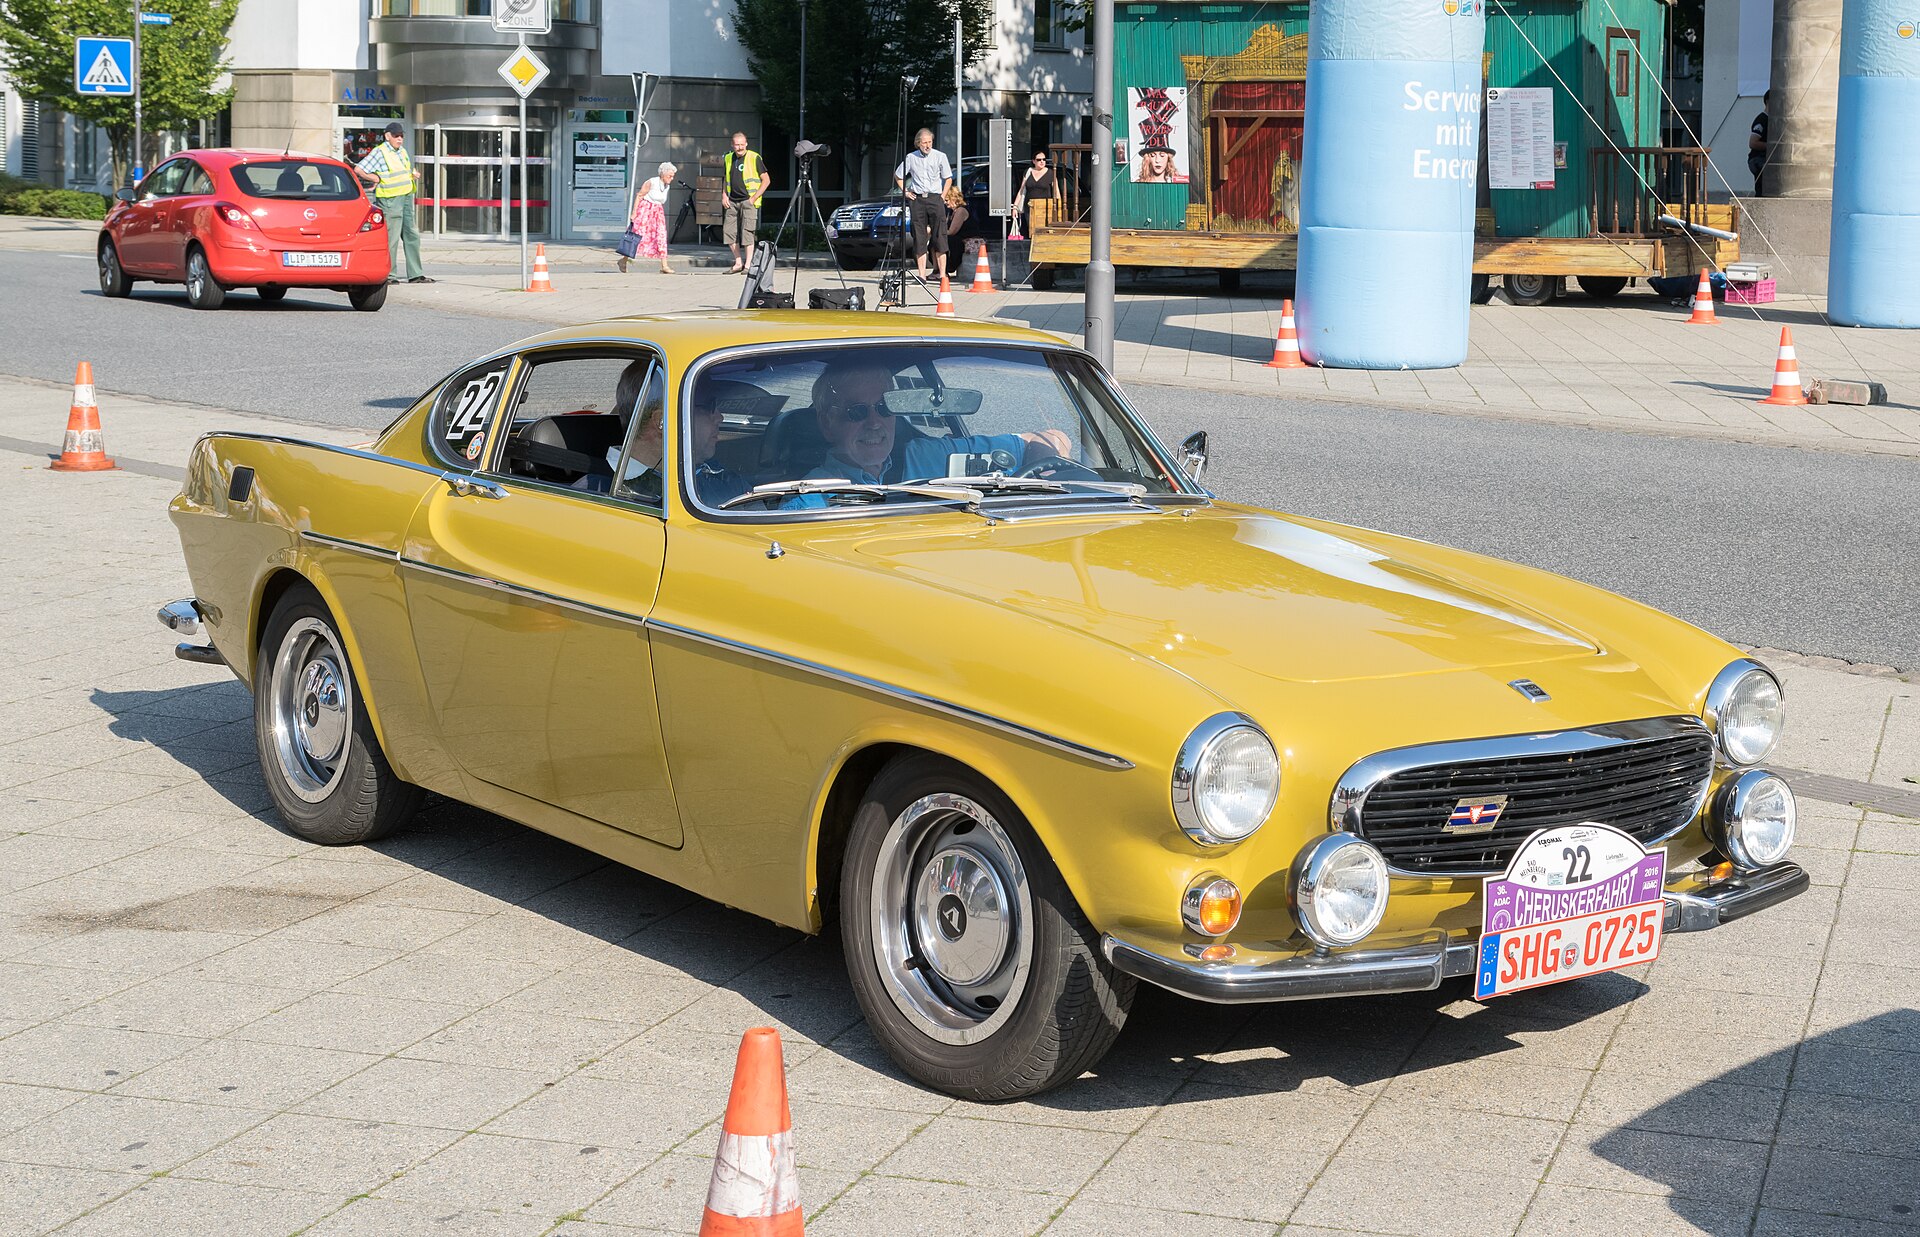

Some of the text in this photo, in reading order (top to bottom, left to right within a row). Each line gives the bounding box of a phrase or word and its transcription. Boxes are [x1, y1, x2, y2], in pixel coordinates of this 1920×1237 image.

[1145, 88, 1168, 99] WAS
[1436, 117, 1472, 147] mit
[290, 254, 339, 264] LIP T 5175
[450, 375, 500, 434] 22
[1526, 859, 1537, 868] BAD
[1562, 844, 1593, 885] 22
[1644, 867, 1659, 878] 2016
[1496, 885, 1508, 896] 36.
[1642, 880, 1658, 891] ADAC
[1514, 866, 1639, 927] CHERUSKERFAHRT
[1493, 897, 1511, 908] ADAC
[1501, 909, 1658, 984] SHG 0725
[1483, 971, 1492, 986] D
